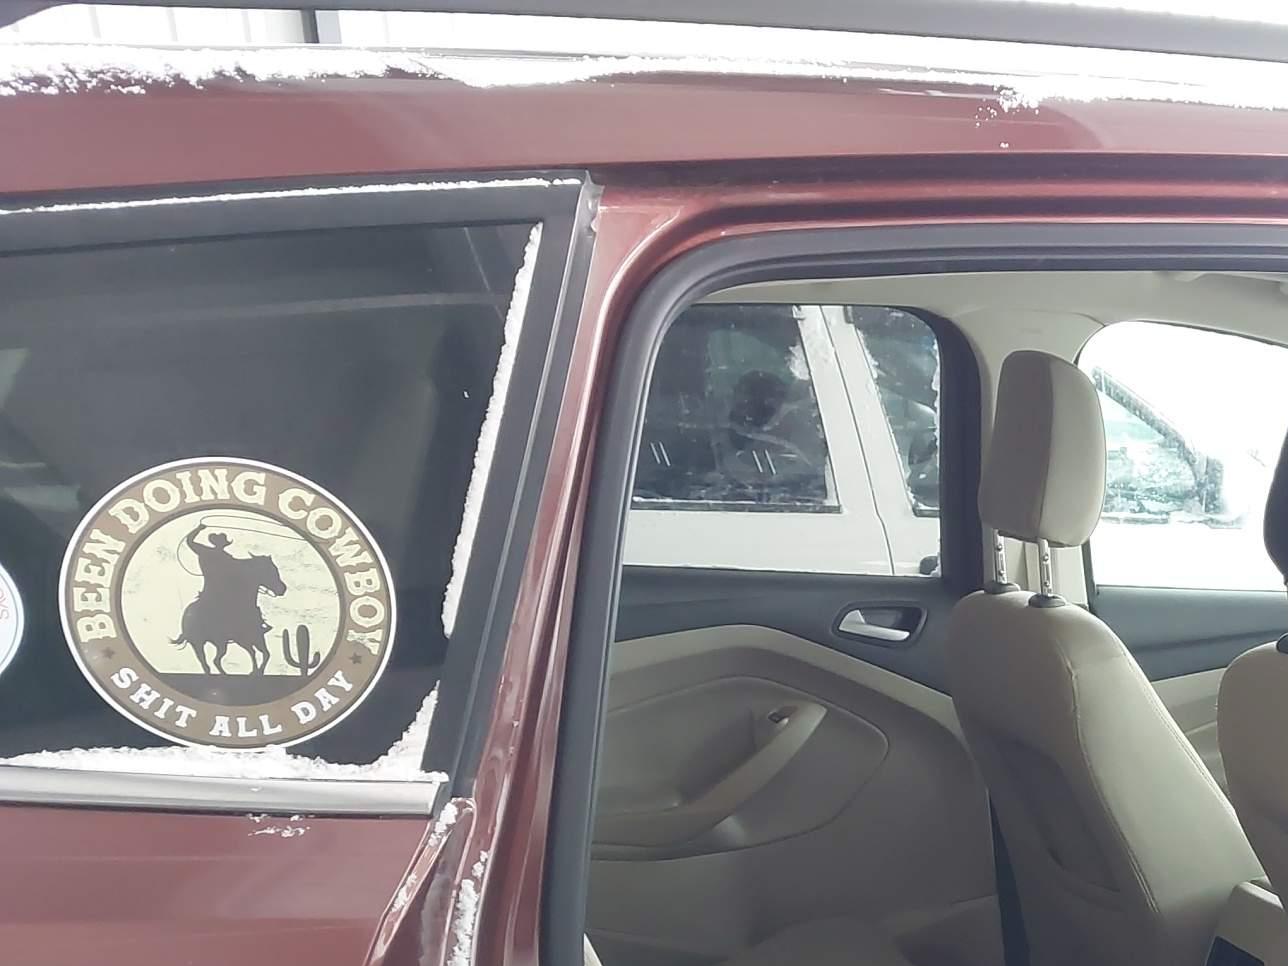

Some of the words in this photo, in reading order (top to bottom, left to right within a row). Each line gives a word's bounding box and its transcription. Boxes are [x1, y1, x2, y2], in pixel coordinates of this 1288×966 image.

[73, 528, 126, 643] BEEN
[109, 468, 267, 534] DOING
[277, 487, 386, 656] COWBOY
[110, 666, 198, 729] SHIT
[209, 714, 283, 738] ALL
[289, 670, 356, 725] DAY
